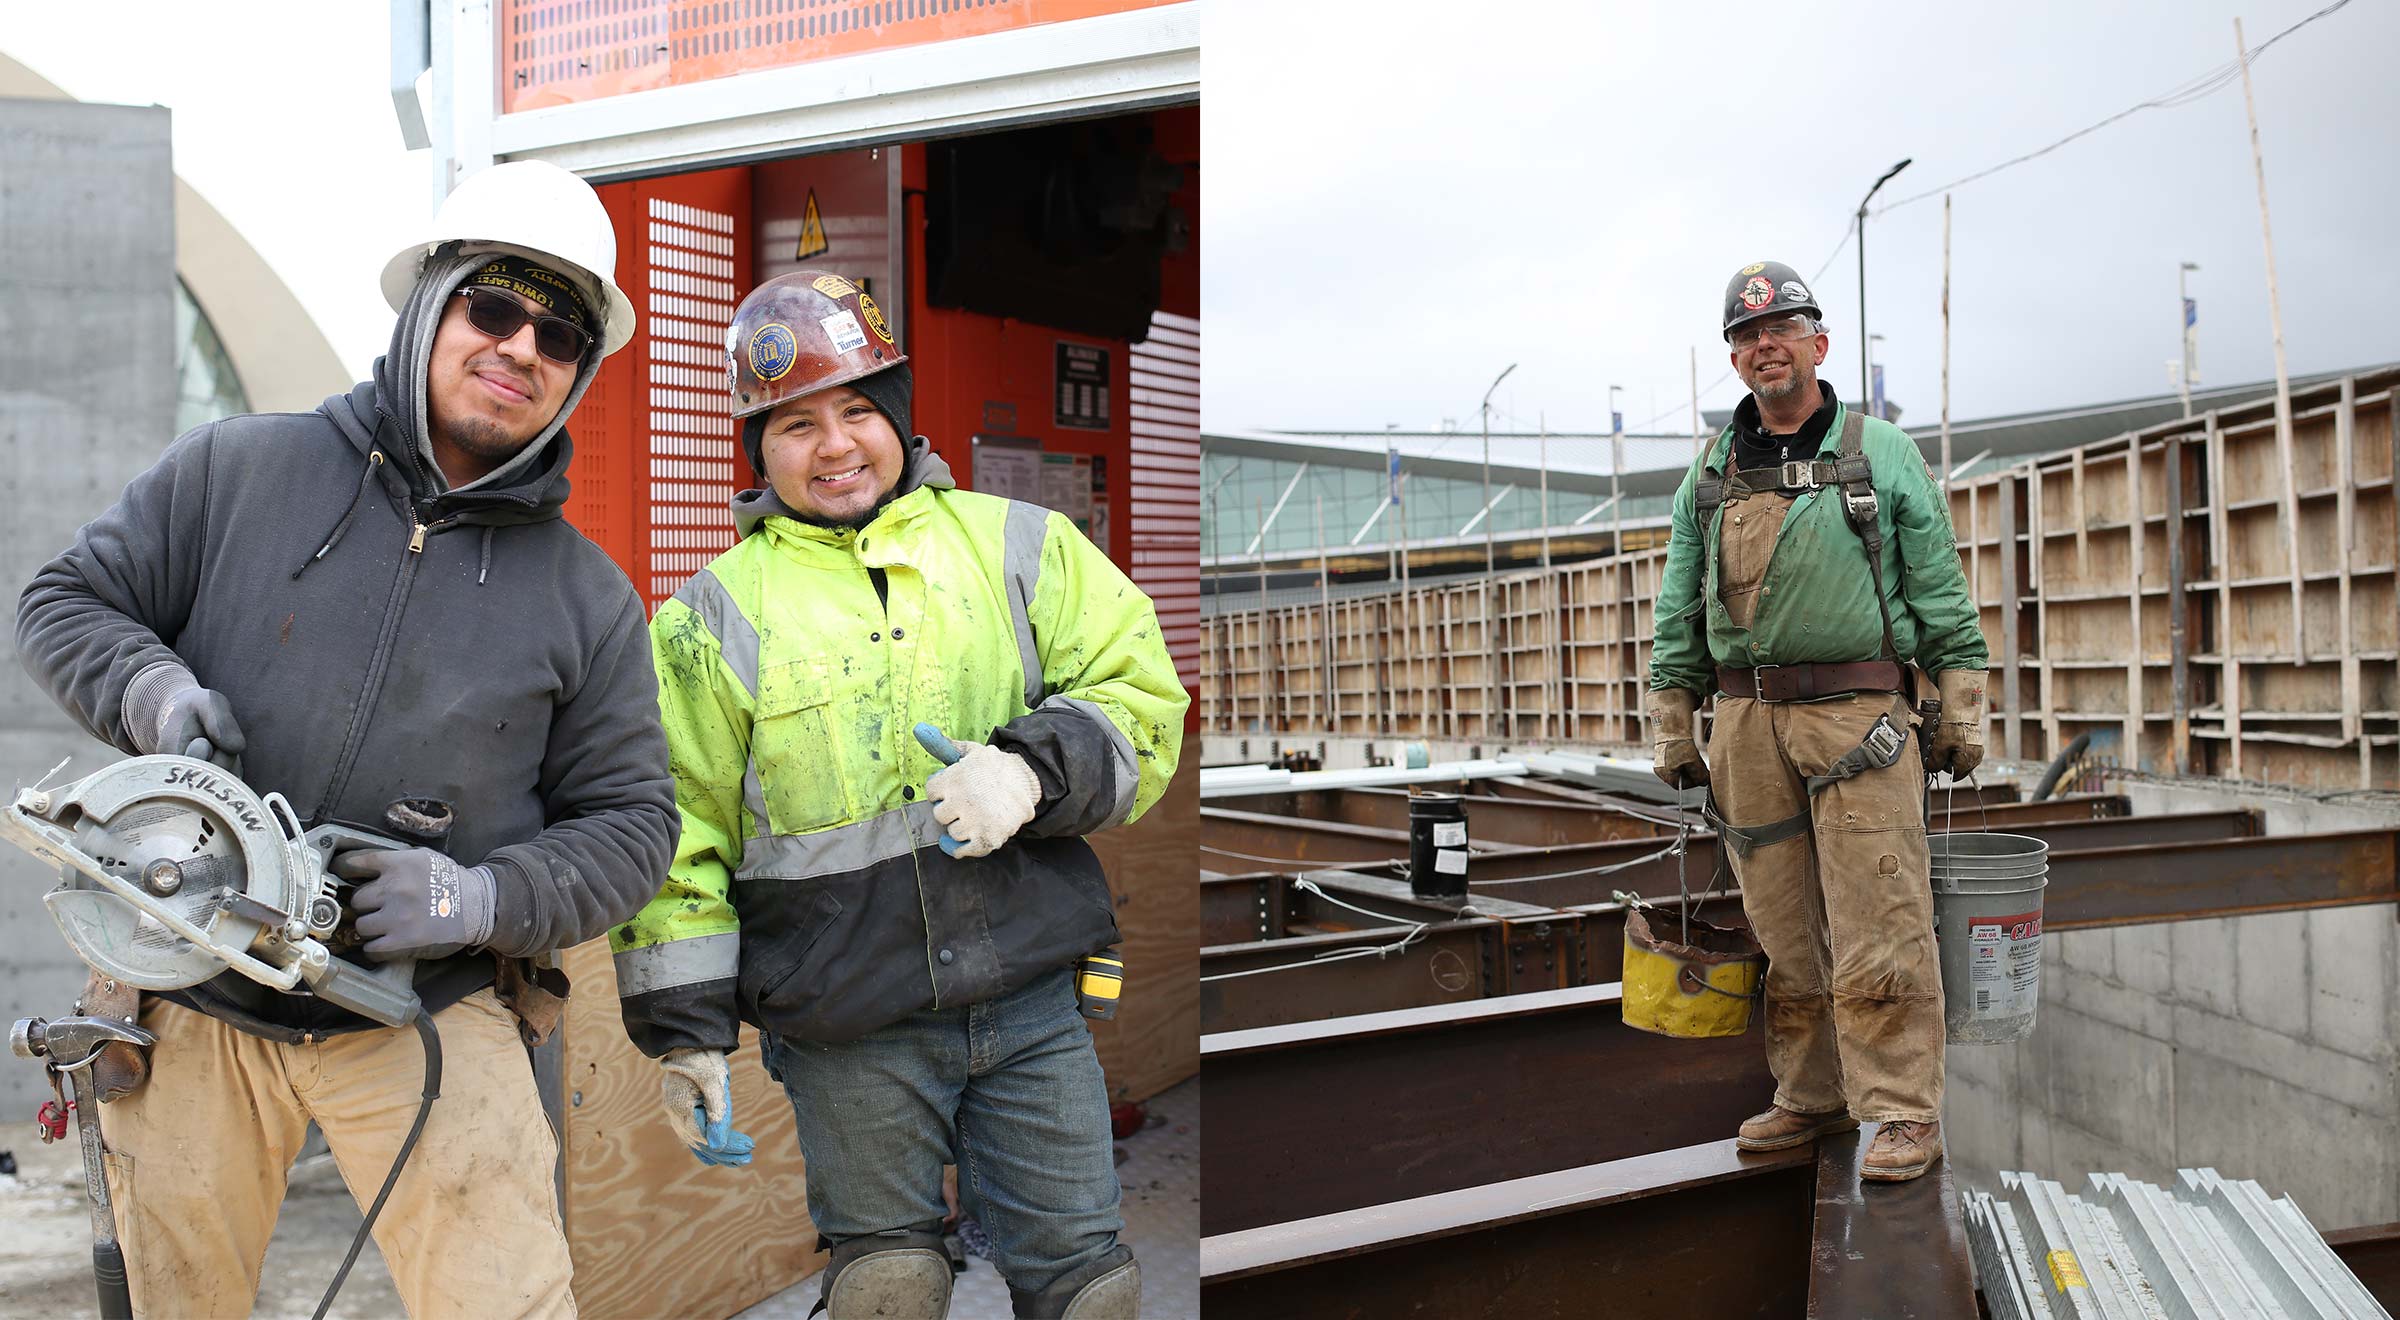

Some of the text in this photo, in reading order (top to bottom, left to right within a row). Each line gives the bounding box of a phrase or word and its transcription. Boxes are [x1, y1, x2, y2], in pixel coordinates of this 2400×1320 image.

[512, 284, 547, 305] OWN
[837, 337, 864, 351] Turner
[164, 766, 265, 831] SKILSAW
